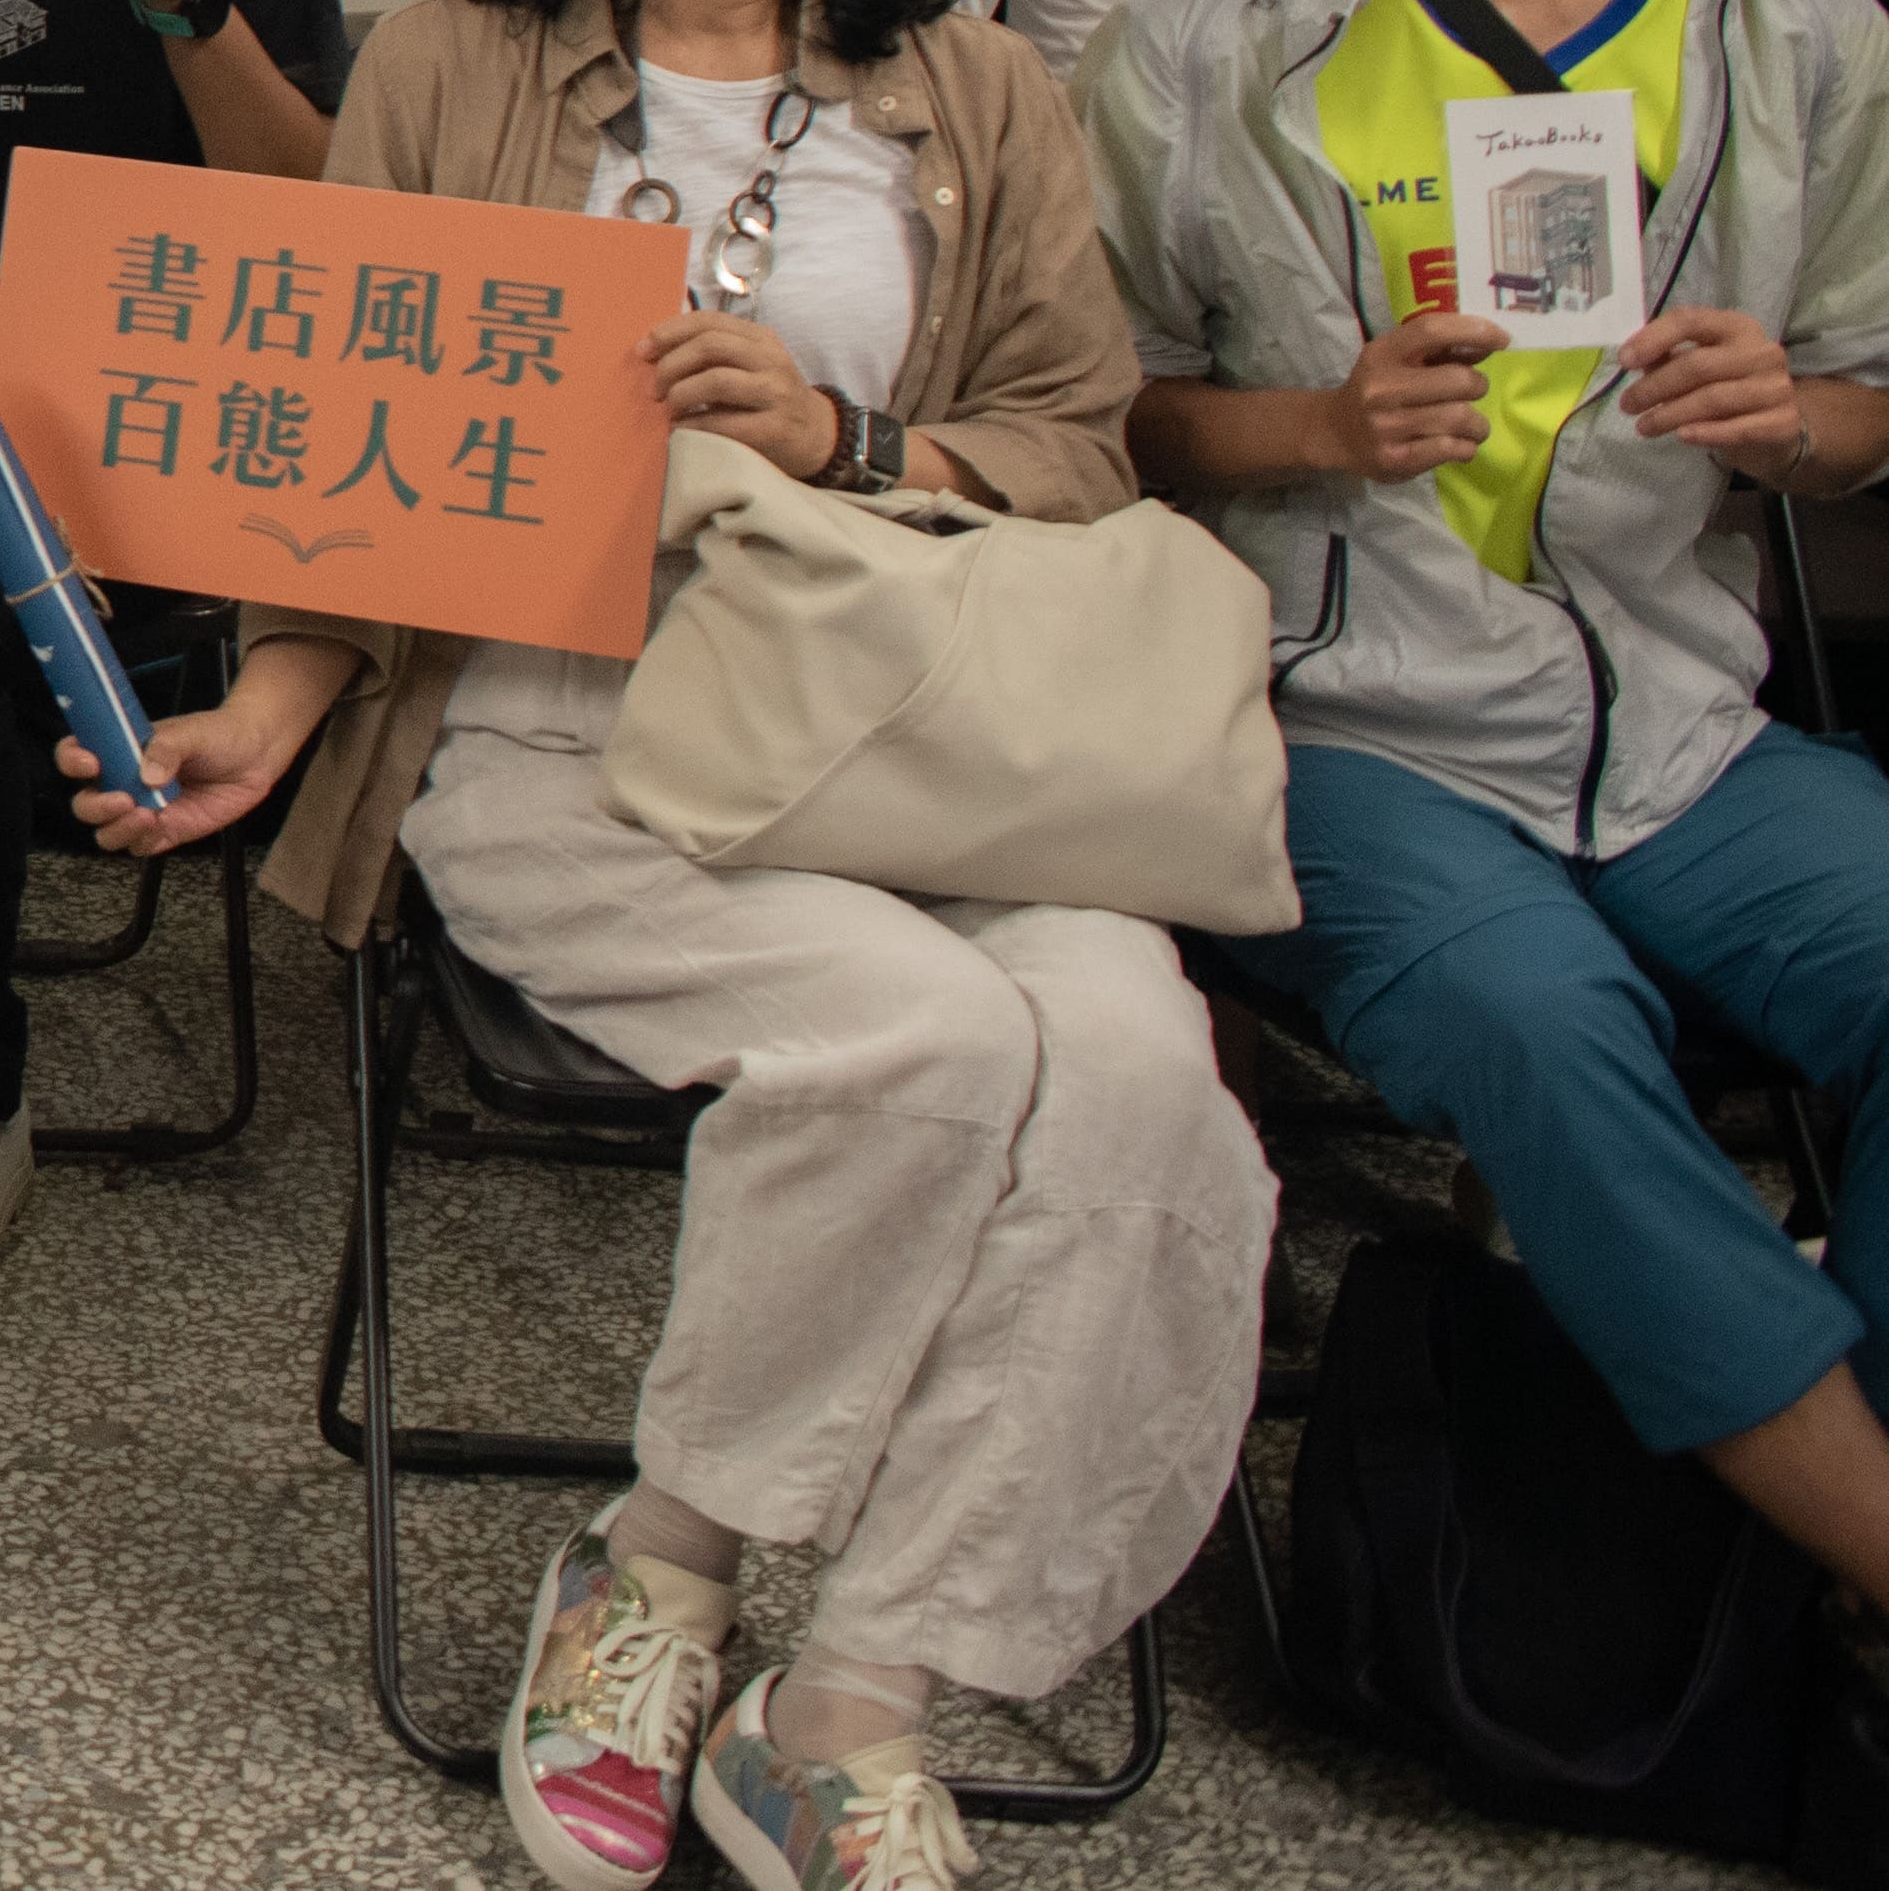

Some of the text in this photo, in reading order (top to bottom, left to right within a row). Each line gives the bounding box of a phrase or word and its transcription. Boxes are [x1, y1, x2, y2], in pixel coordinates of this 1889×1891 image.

[106, 233, 571, 387] 書店風景
[99, 367, 548, 526] 百態人生
